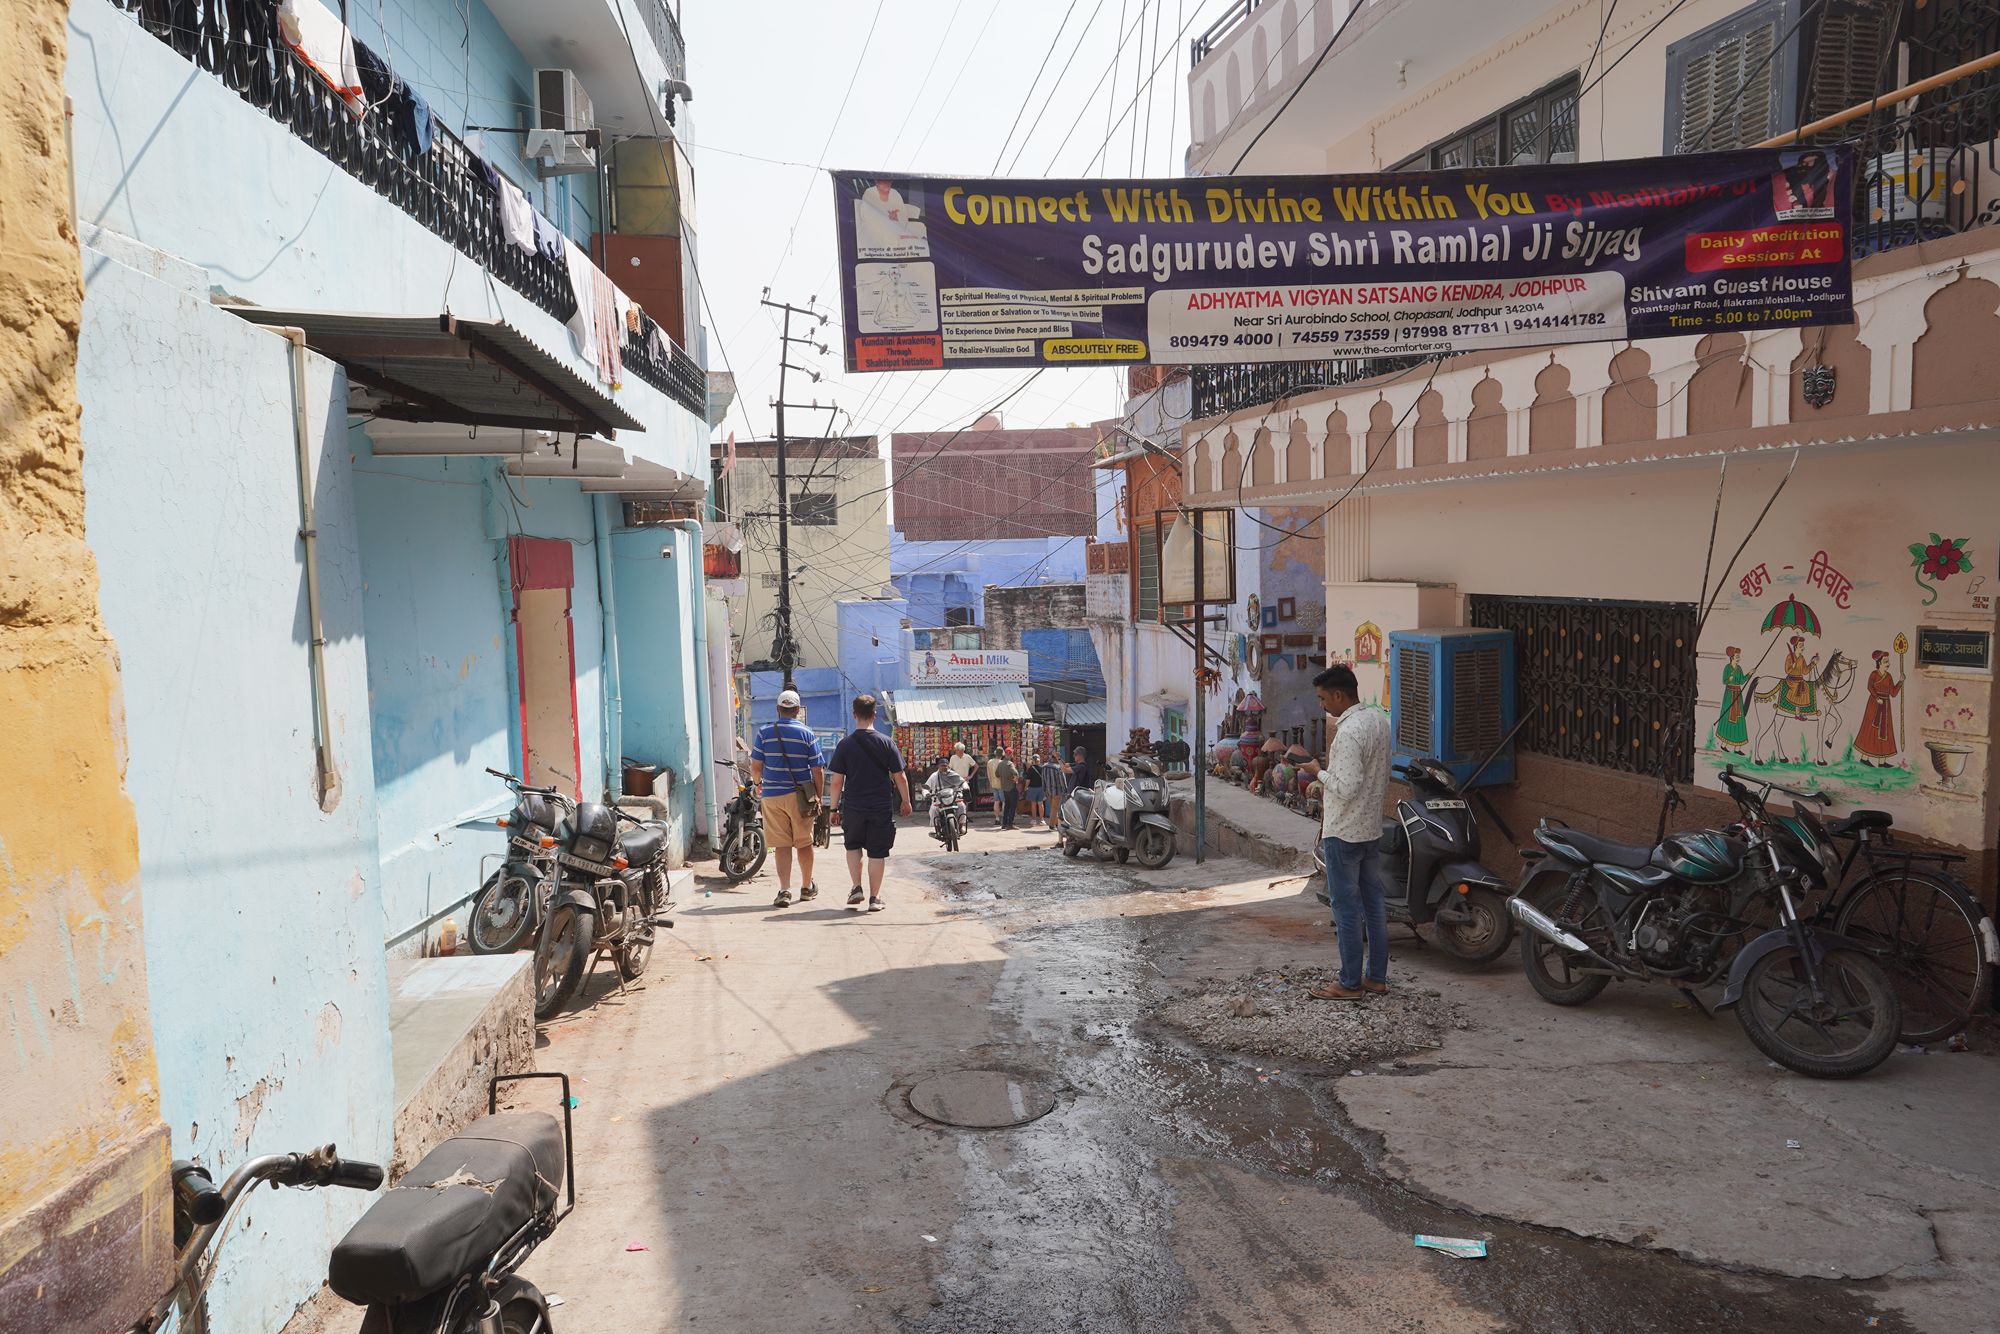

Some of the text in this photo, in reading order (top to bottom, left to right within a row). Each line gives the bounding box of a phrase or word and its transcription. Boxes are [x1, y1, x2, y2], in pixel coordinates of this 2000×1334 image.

[944, 186, 1091, 226] Connect
[1102, 188, 1194, 223] With
[1205, 187, 1323, 223] Divine
[1333, 185, 1457, 222] Within
[1465, 183, 1535, 220] You
[1544, 193, 1583, 217] By
[1700, 229, 1840, 249] Daily Meditation
[1082, 220, 1645, 283] Sadgurudev Shri Ramlal Ji Siyag
[1722, 248, 1822, 264] Sessions At
[942, 293, 953, 302] For
[954, 292, 983, 301] Spiritual
[984, 292, 1010, 301] Healing
[1049, 294, 1073, 302] Mental
[1081, 293, 1110, 302] Spiritual
[1111, 292, 1143, 301] Problems
[1187, 277, 1587, 311] ADHYATMA VIGYAN SATSANG KENDRA, JODHPUR
[1629, 274, 1833, 303] Shivam Guest House
[943, 310, 955, 318] For
[956, 309, 990, 318] Liberation
[1000, 308, 1031, 317] Salvation
[1079, 310, 1100, 318] Divine
[1631, 292, 1846, 315] Ghantaghar Road, Makrana Mohalla, Jodhpur
[1234, 302, 1544, 327] Near Sri Aurobindo School, Chopasani, Jodhpur 342014
[1669, 315, 1703, 328] Time
[1715, 311, 1744, 324] 5.00
[1747, 311, 1760, 322] to
[1763, 308, 1813, 323] 7.00pm
[955, 327, 993, 337] Experience
[994, 327, 1015, 335] Divine
[1017, 326, 1038, 334] Peace
[1039, 326, 1052, 334] and
[1053, 325, 1070, 333] Bliss
[1170, 334, 1229, 348] 809479
[1233, 332, 1274, 347] 4000
[1292, 330, 1339, 344] 74559
[1344, 328, 1390, 342] 73559
[1402, 325, 1448, 339] 97998
[1452, 321, 1499, 336] 87781
[1514, 312, 1606, 331] 9414141782
[886, 347, 912, 356] Through
[949, 345, 1030, 354] To Realize-Visualize God
[1051, 344, 1139, 355] ABSOLUTELY FREE
[1739, 563, 1771, 597] शुभ
[1806, 550, 1854, 609] विवाह
[947, 653, 1009, 666] Amul Milk
